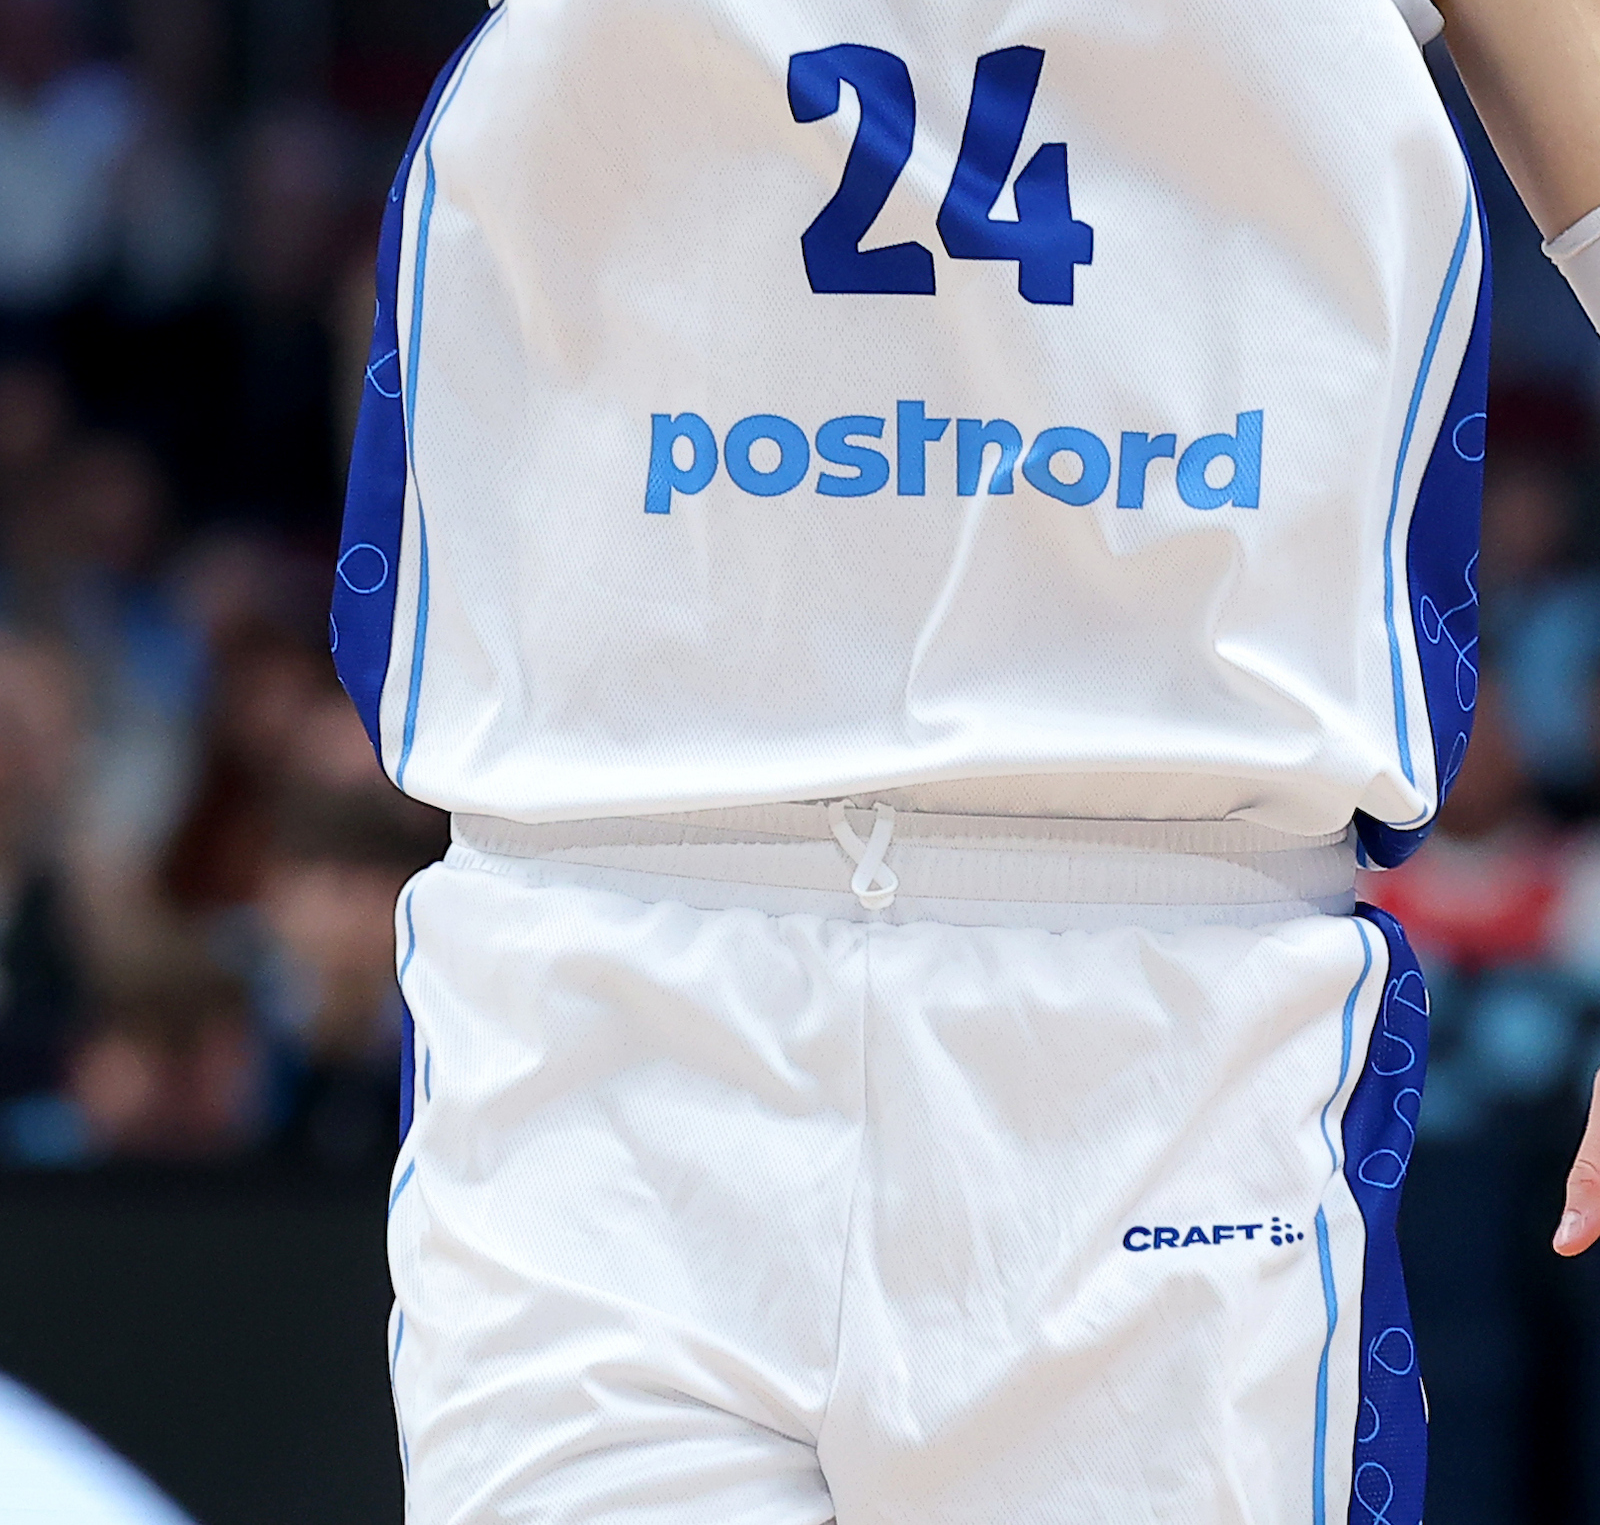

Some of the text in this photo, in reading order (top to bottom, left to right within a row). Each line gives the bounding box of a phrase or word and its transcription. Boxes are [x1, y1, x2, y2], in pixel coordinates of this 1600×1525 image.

[787, 43, 1094, 306] 24
[643, 400, 1264, 515] postnord
[1122, 1224, 1263, 1252] CRAFT
